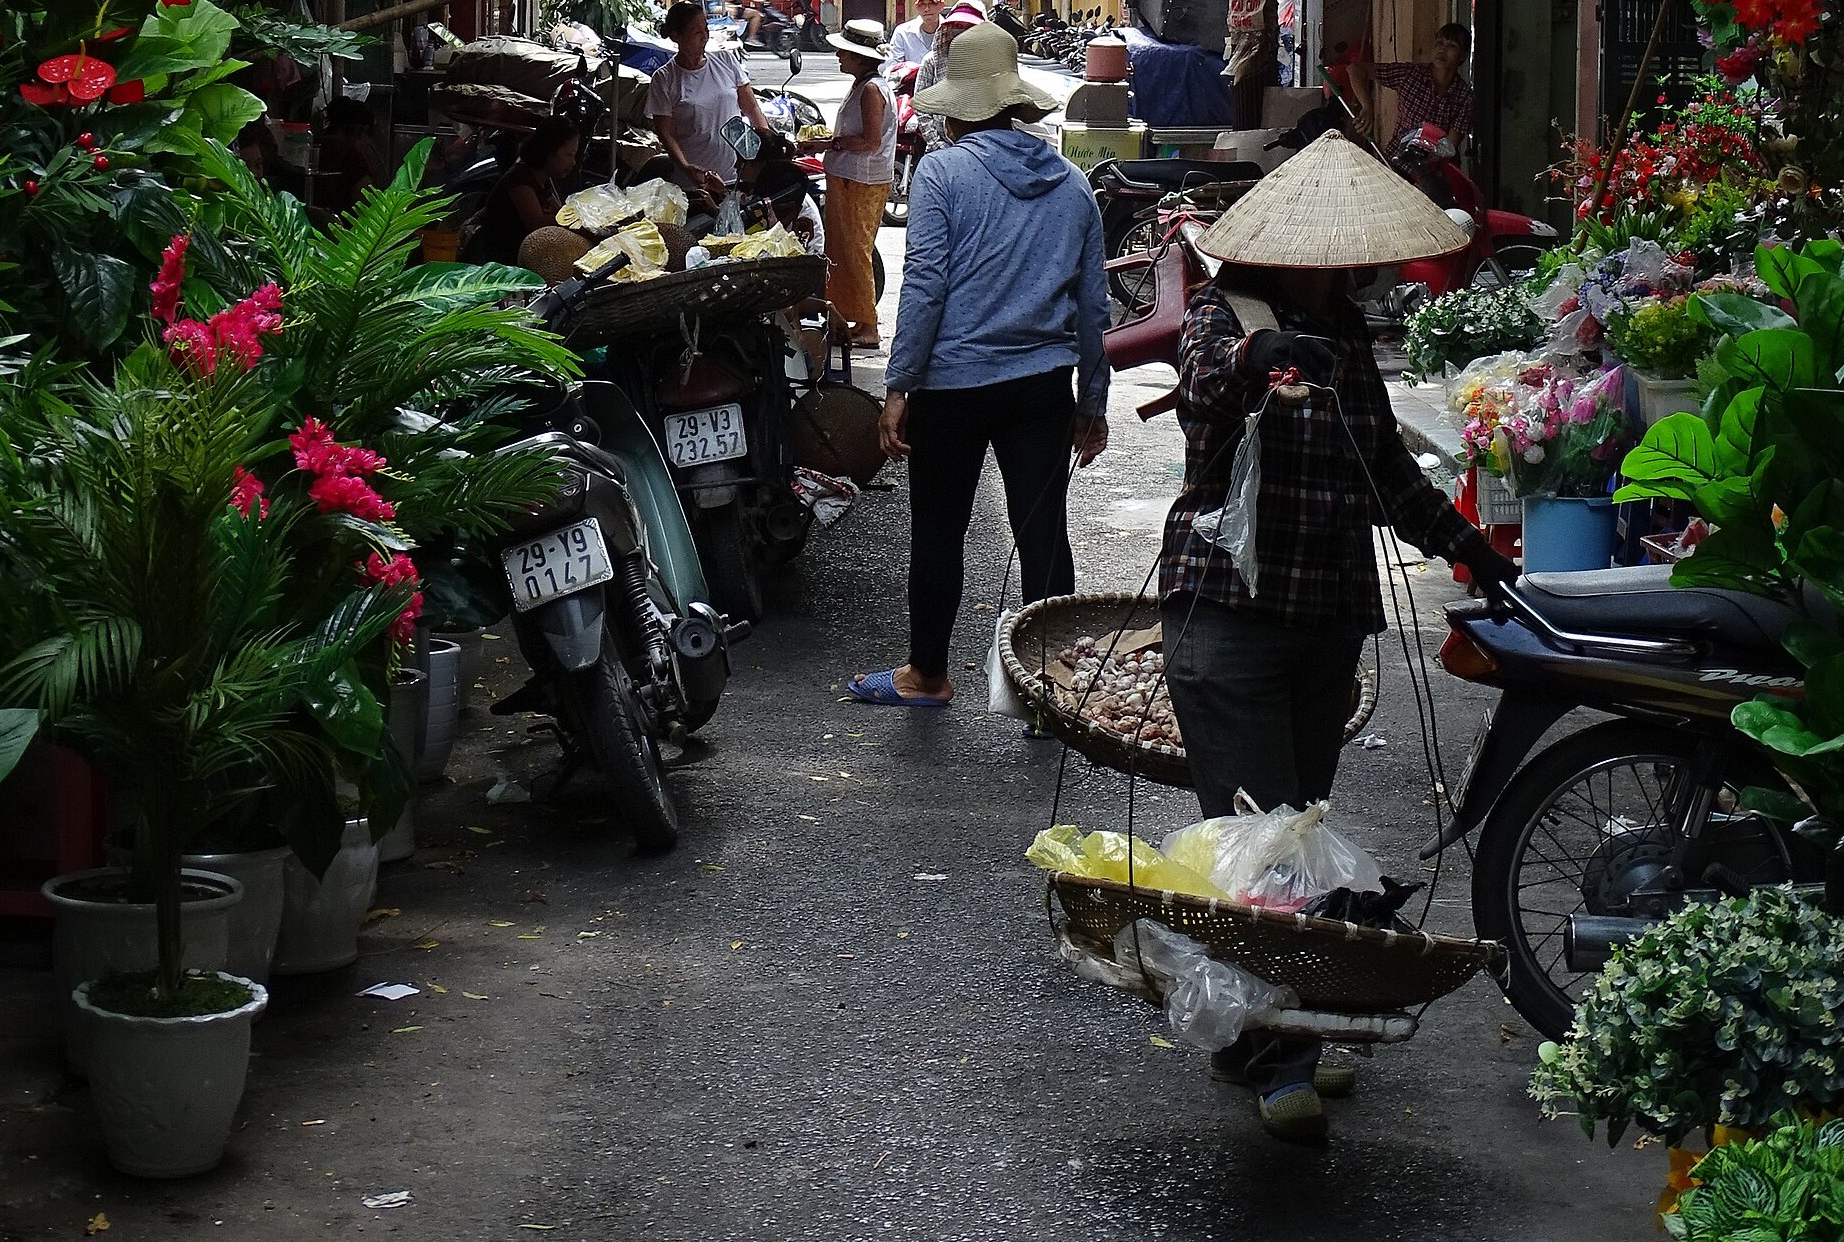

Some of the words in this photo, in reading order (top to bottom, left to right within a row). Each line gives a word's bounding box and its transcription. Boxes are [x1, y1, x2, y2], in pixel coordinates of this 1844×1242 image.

[676, 409, 732, 440] 29-V3
[673, 431, 740, 465] 232.57
[516, 527, 589, 576] 29-Y9
[524, 554, 592, 599] 0147
